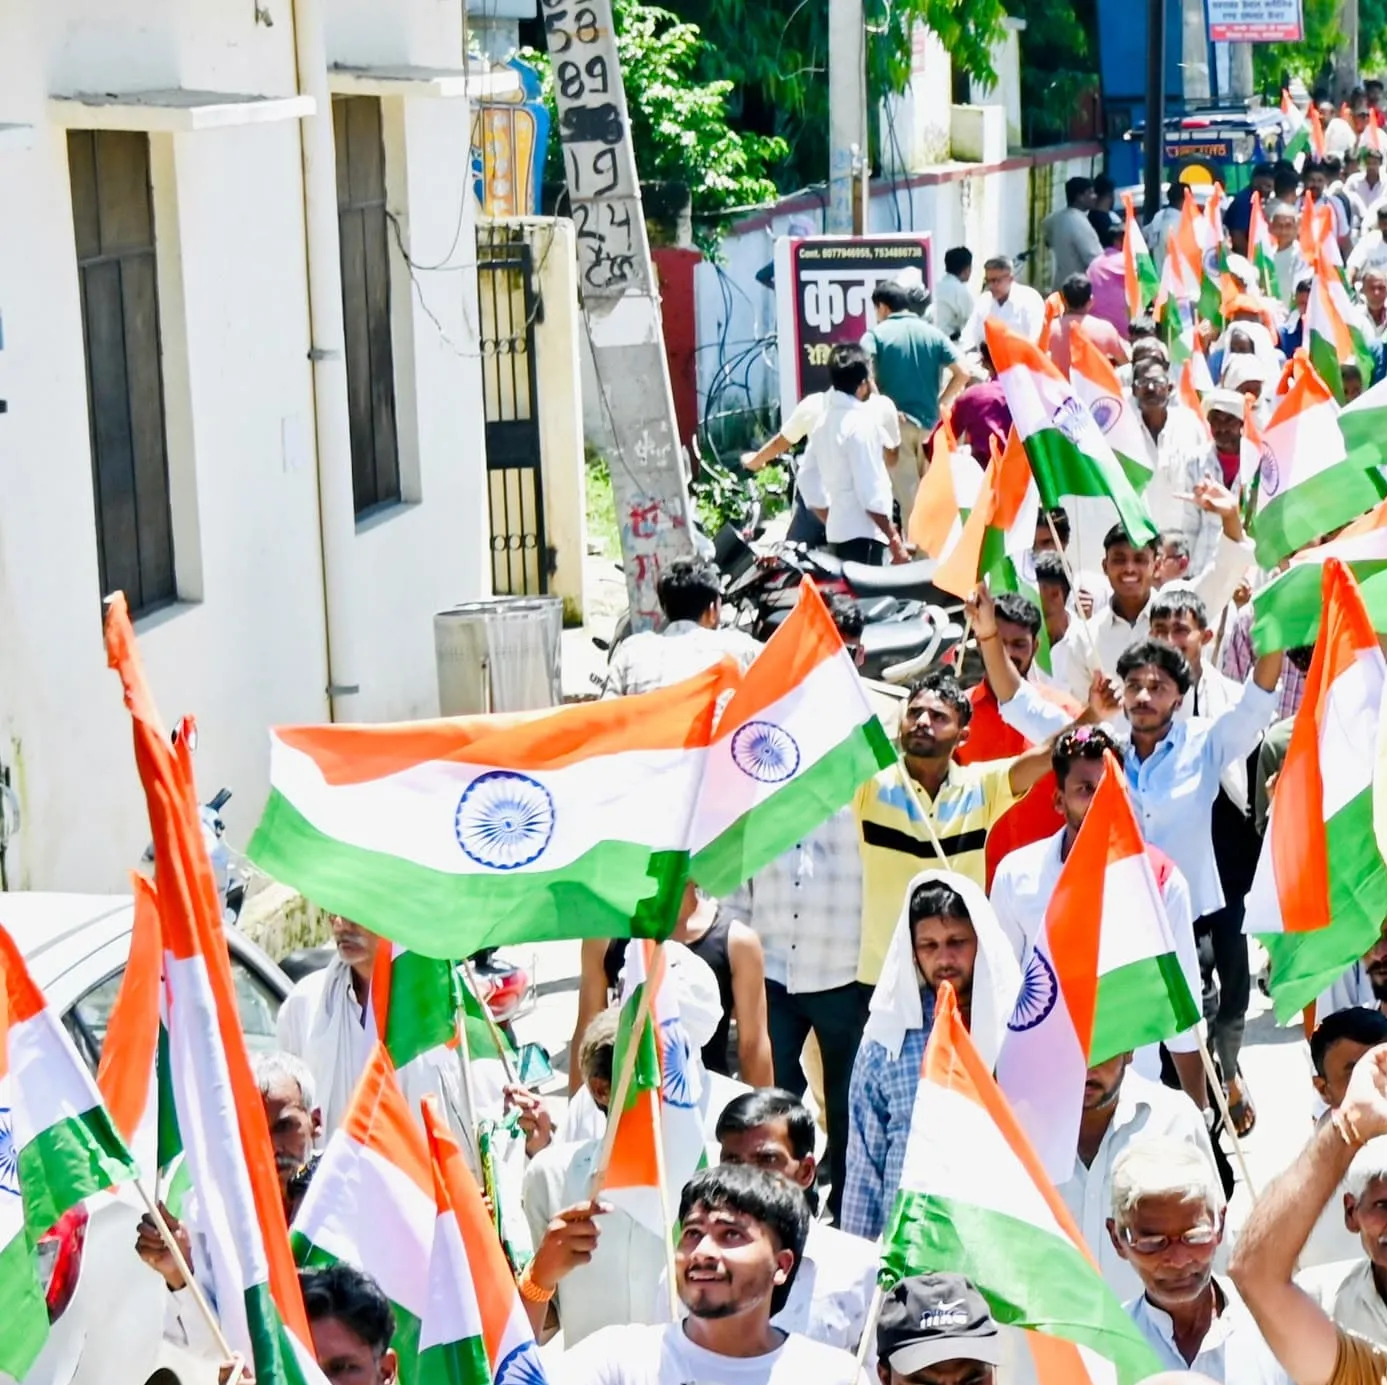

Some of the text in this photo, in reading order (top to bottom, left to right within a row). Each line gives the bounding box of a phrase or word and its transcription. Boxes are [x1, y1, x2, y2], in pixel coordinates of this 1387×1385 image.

[546, 8, 599, 53] 58
[557, 55, 609, 99] 89
[569, 147, 619, 196] 19
[573, 203, 632, 251] 24
